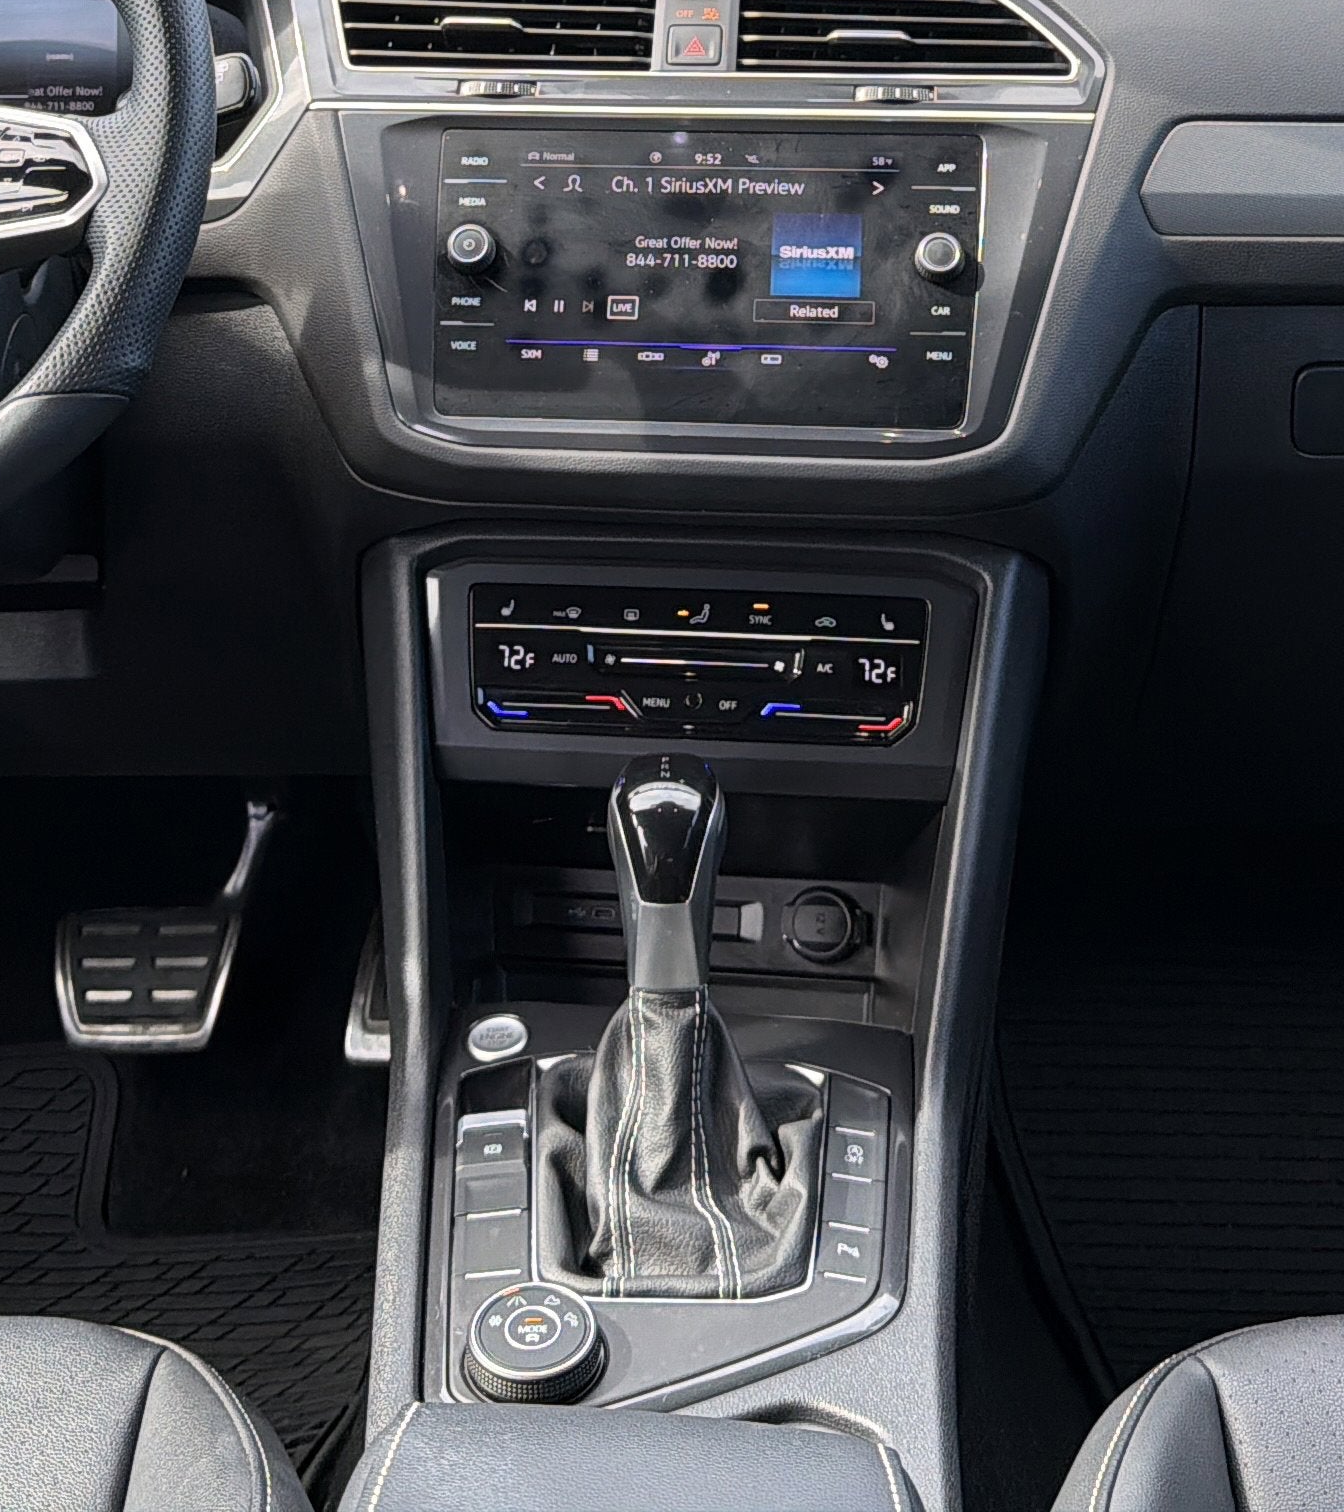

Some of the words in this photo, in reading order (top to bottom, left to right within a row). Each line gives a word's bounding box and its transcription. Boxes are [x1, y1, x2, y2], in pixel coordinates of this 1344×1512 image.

[47, 86, 73, 97] Offer
[75, 86, 104, 97] Now!
[460, 156, 489, 166] RADIO
[542, 151, 575, 162] Normal
[694, 153, 723, 165] 9:52
[936, 163, 956, 173] APP
[611, 176, 639, 193] Ch.
[645, 177, 654, 193] 1
[660, 177, 733, 194] SiriusXM
[738, 179, 806, 196] Preview
[458, 197, 487, 207] MEDIA
[928, 204, 960, 215] SOUND
[635, 236, 668, 249] Great
[670, 236, 702, 249] Offer
[705, 237, 739, 250] Now!
[779, 245, 855, 259] SiriusXM
[626, 253, 738, 269] 844-711-8800
[451, 296, 481, 307] PHONE
[612, 302, 633, 313] LIVE
[789, 304, 839, 319] Related
[930, 306, 951, 316] CAR
[450, 341, 477, 351] VOICE
[520, 348, 542, 359] SXM
[925, 351, 953, 361] MENU
[748, 615, 773, 626] SYNC
[552, 653, 578, 664] AUTO
[816, 663, 834, 674] A/C
[642, 697, 670, 708] MENU
[718, 700, 738, 711] OFF
[517, 1324, 549, 1334] MODE
